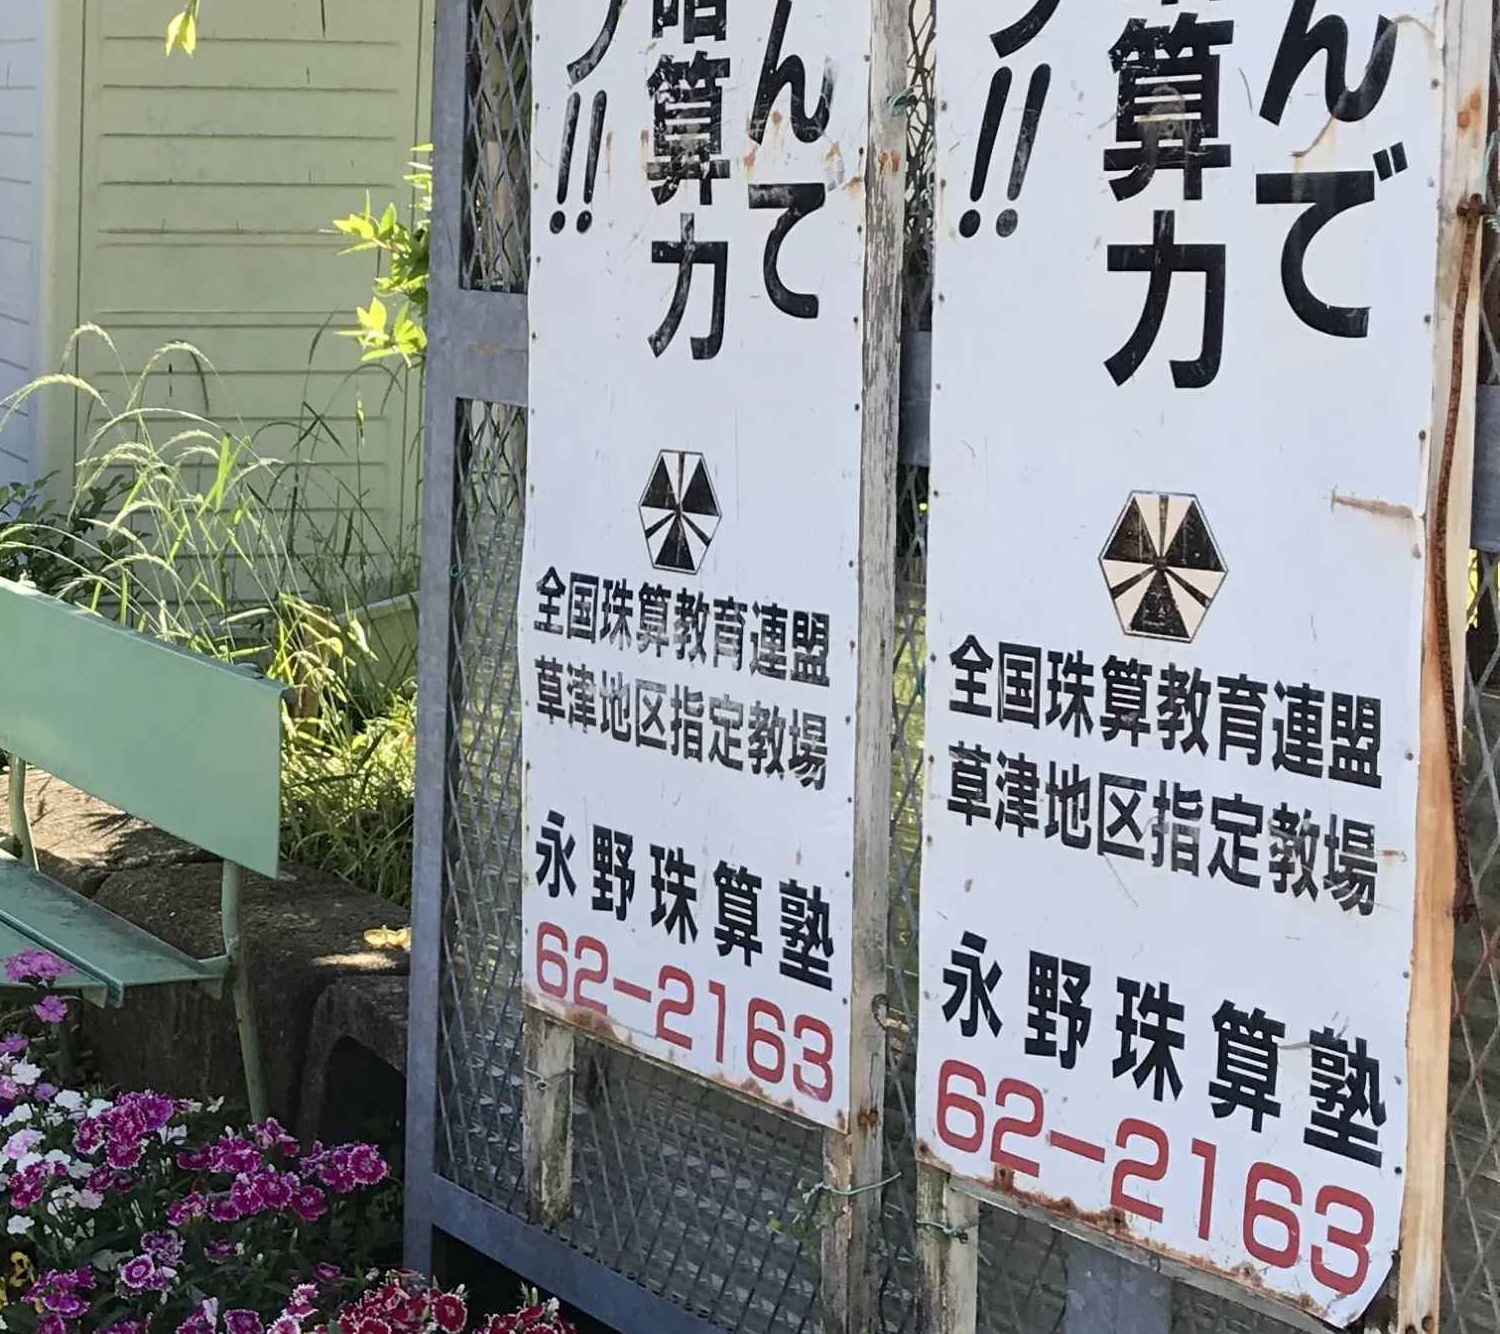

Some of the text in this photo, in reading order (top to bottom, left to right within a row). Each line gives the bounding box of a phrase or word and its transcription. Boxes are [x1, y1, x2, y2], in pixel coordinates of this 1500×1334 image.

[534, 566, 830, 688] 全国珠算教育連盟
[534, 655, 828, 791] 草津地区指定教場
[949, 634, 1383, 790] 全国珠算教育連盟
[535, 809, 834, 992] 永野珠算塾
[947, 740, 1378, 916] 草津地区指定教場
[942, 930, 1387, 1168] 永野珠算塾
